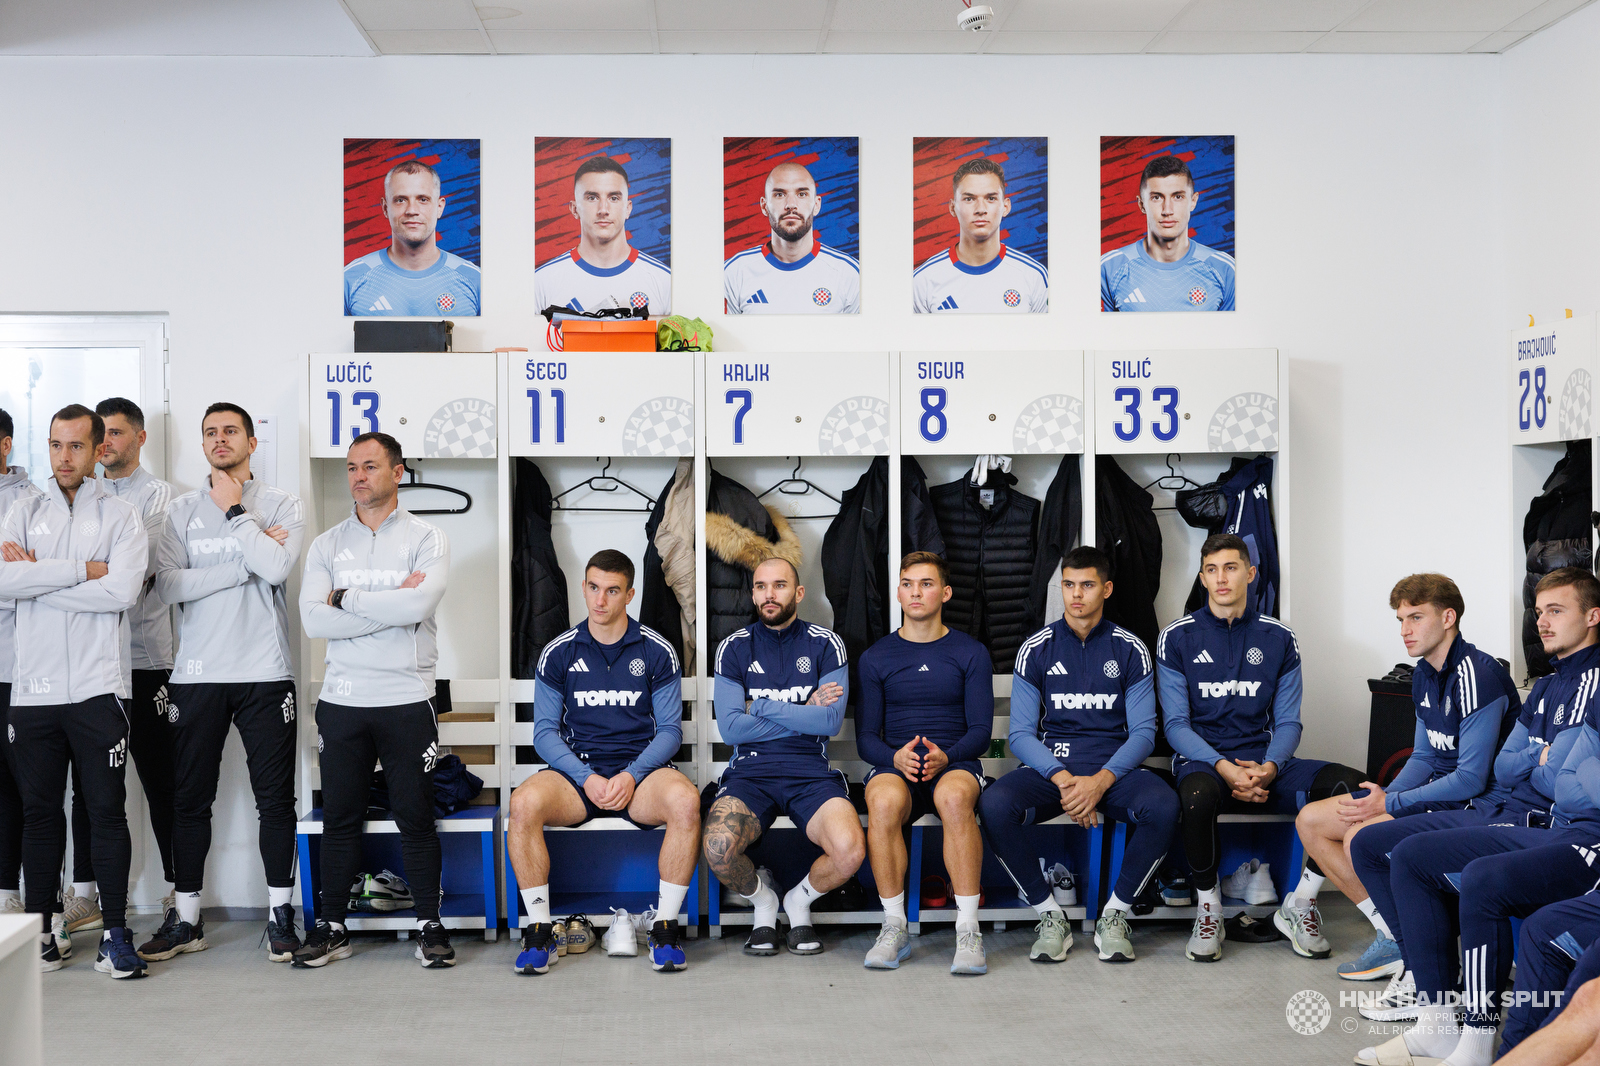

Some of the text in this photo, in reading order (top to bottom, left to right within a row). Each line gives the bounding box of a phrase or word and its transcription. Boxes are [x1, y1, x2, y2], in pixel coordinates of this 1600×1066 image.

[1518, 331, 1556, 361] BRAJKOVIĆ
[327, 361, 372, 383] LUČIĆ
[526, 359, 567, 380] ŠEGO
[723, 364, 769, 381] KALIK
[918, 361, 964, 379] SIGUR
[1112, 357, 1151, 378] SILIĆ
[526, 387, 567, 445] 11
[724, 388, 754, 445] 7
[918, 386, 949, 444] 8
[1113, 385, 1180, 443] 33
[1209, 394, 1277, 437] HAJDUK
[1519, 365, 1547, 432] 28
[326, 389, 382, 447] 13
[425, 399, 495, 443] HAJDUK
[624, 398, 693, 441] HAJDUK
[820, 398, 888, 441] HAJDUK
[1014, 396, 1082, 439] HAJDUK
[189, 536, 242, 556] TOMM
[573, 690, 643, 707] TOMMY
[1050, 693, 1119, 710] TOMMY
[1198, 680, 1262, 698] TOMMY
[1053, 743, 1071, 758] 25
